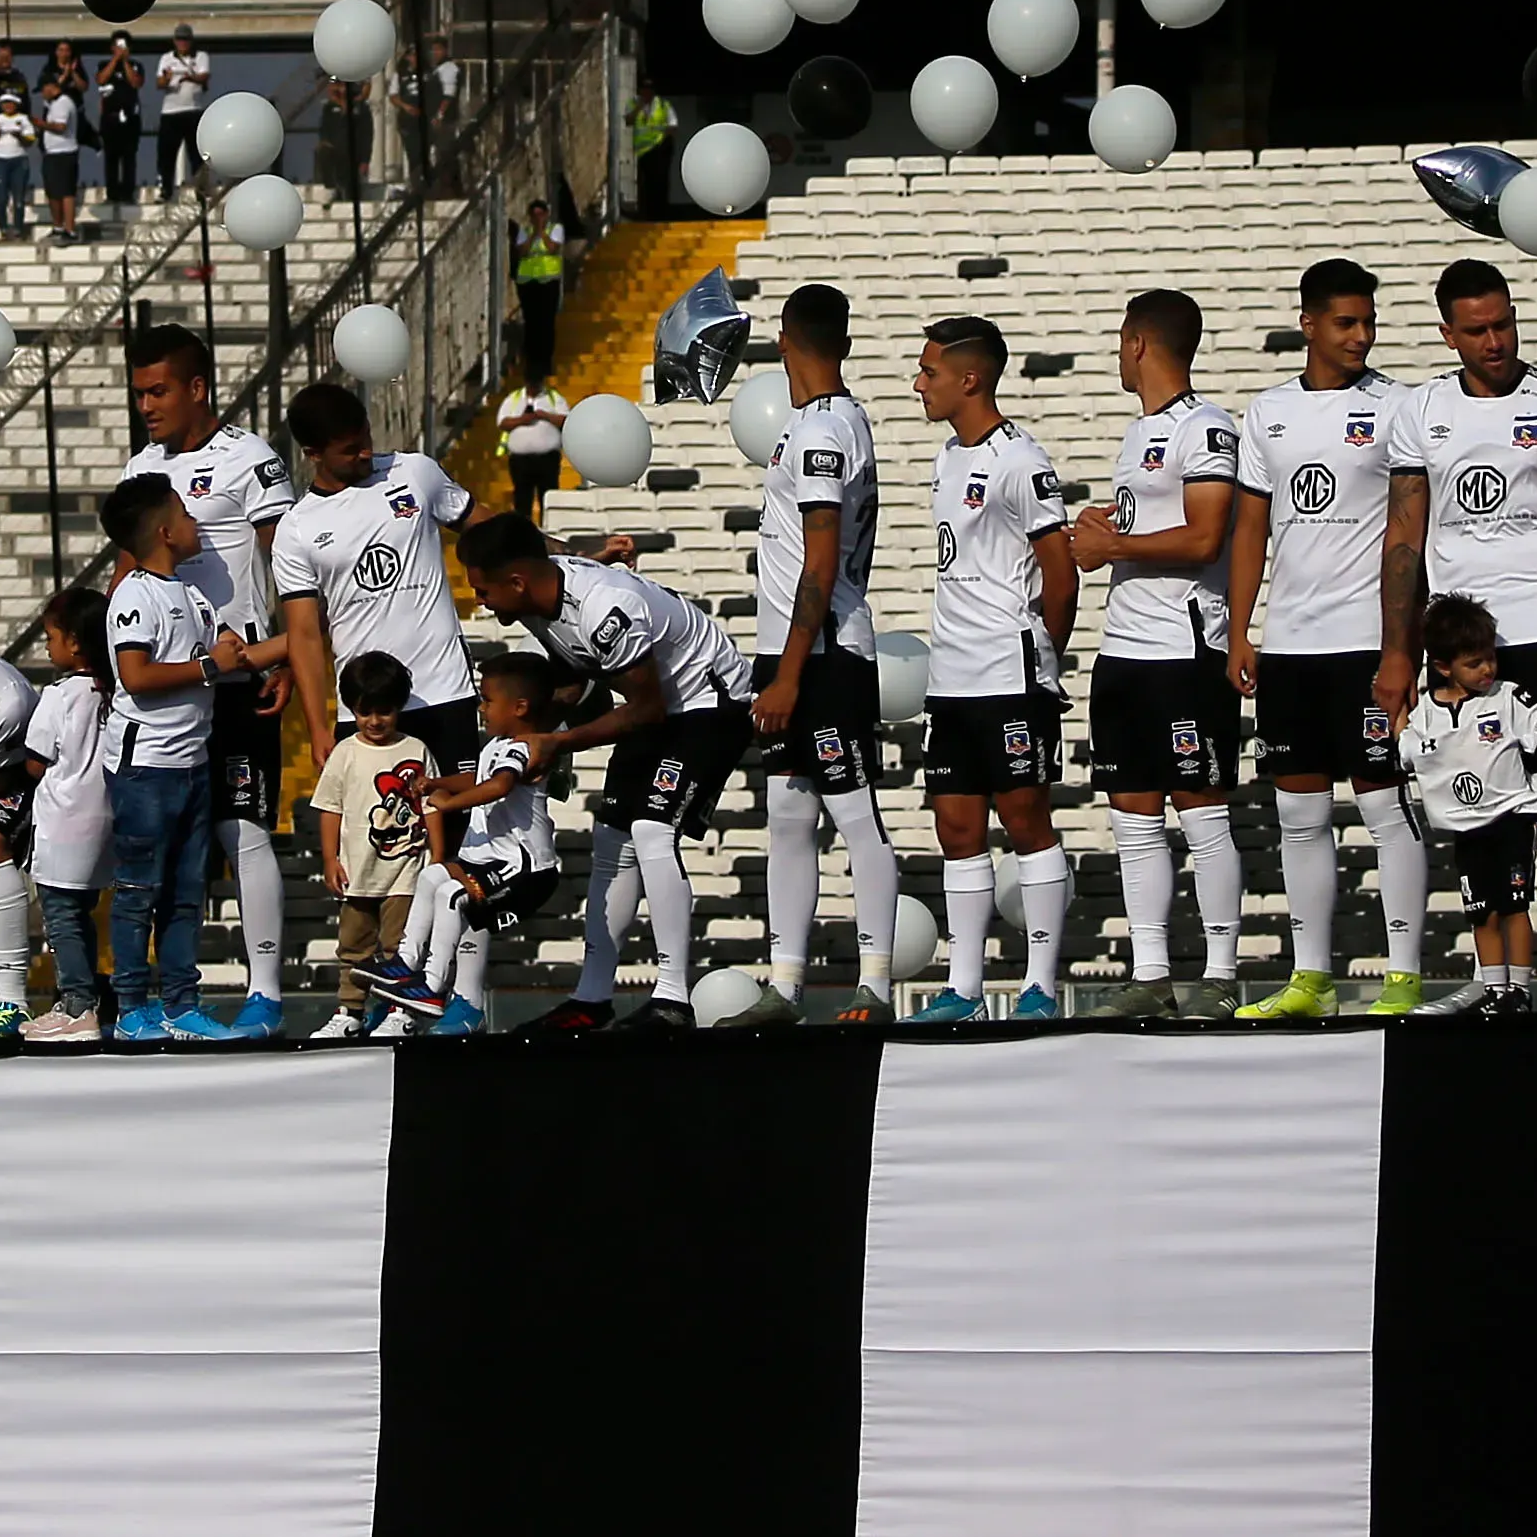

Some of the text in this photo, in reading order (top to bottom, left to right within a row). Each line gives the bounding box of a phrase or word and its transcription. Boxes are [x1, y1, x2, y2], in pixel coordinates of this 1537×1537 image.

[1296, 469, 1331, 509] MG
[1462, 471, 1502, 510] MG
[358, 548, 396, 586] MG
[1456, 775, 1479, 803] MG
